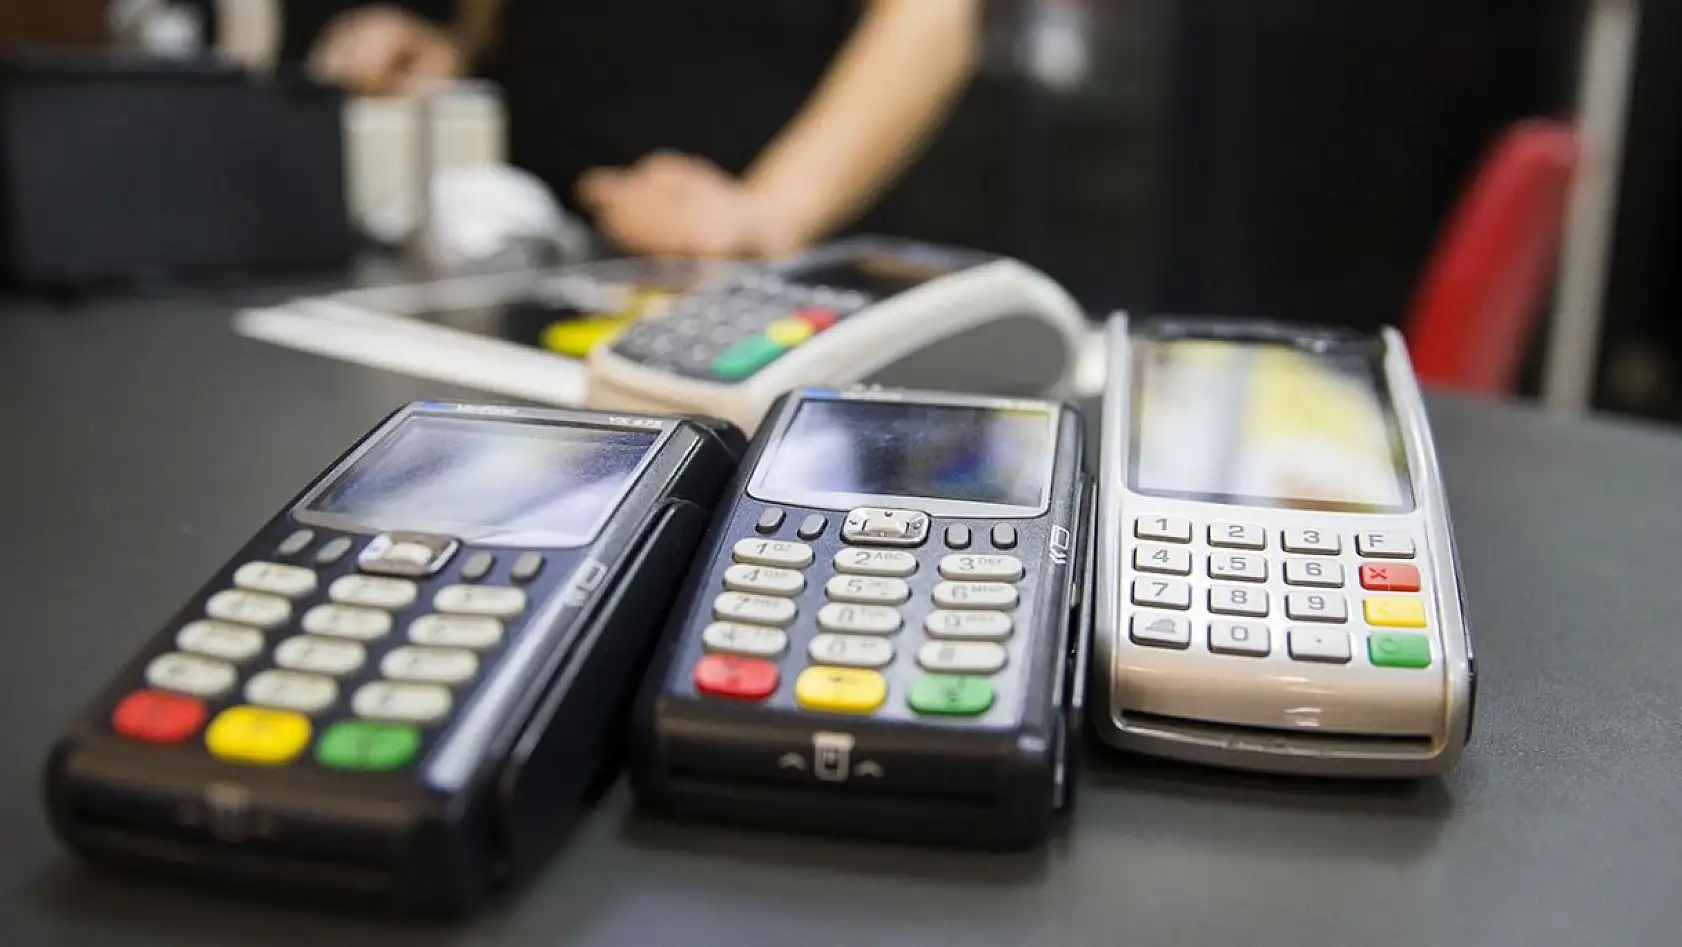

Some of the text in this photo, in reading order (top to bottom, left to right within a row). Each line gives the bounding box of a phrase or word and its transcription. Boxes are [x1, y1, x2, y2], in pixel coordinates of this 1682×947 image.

[1155, 518, 1168, 531] 1
[1228, 525, 1245, 538] 2
[1303, 530, 1321, 544] 3
[1369, 534, 1384, 548] F
[756, 542, 769, 555] 1
[853, 551, 871, 566] 2
[1152, 549, 1170, 563] 4
[959, 557, 975, 571] 3
[1229, 557, 1247, 571] 5
[1305, 562, 1322, 576] 6
[743, 569, 761, 581] 4
[846, 579, 863, 592] 5
[1152, 581, 1169, 597] 7
[1231, 590, 1248, 604] 8
[1308, 595, 1325, 611] 9
[1231, 625, 1248, 642] 0
